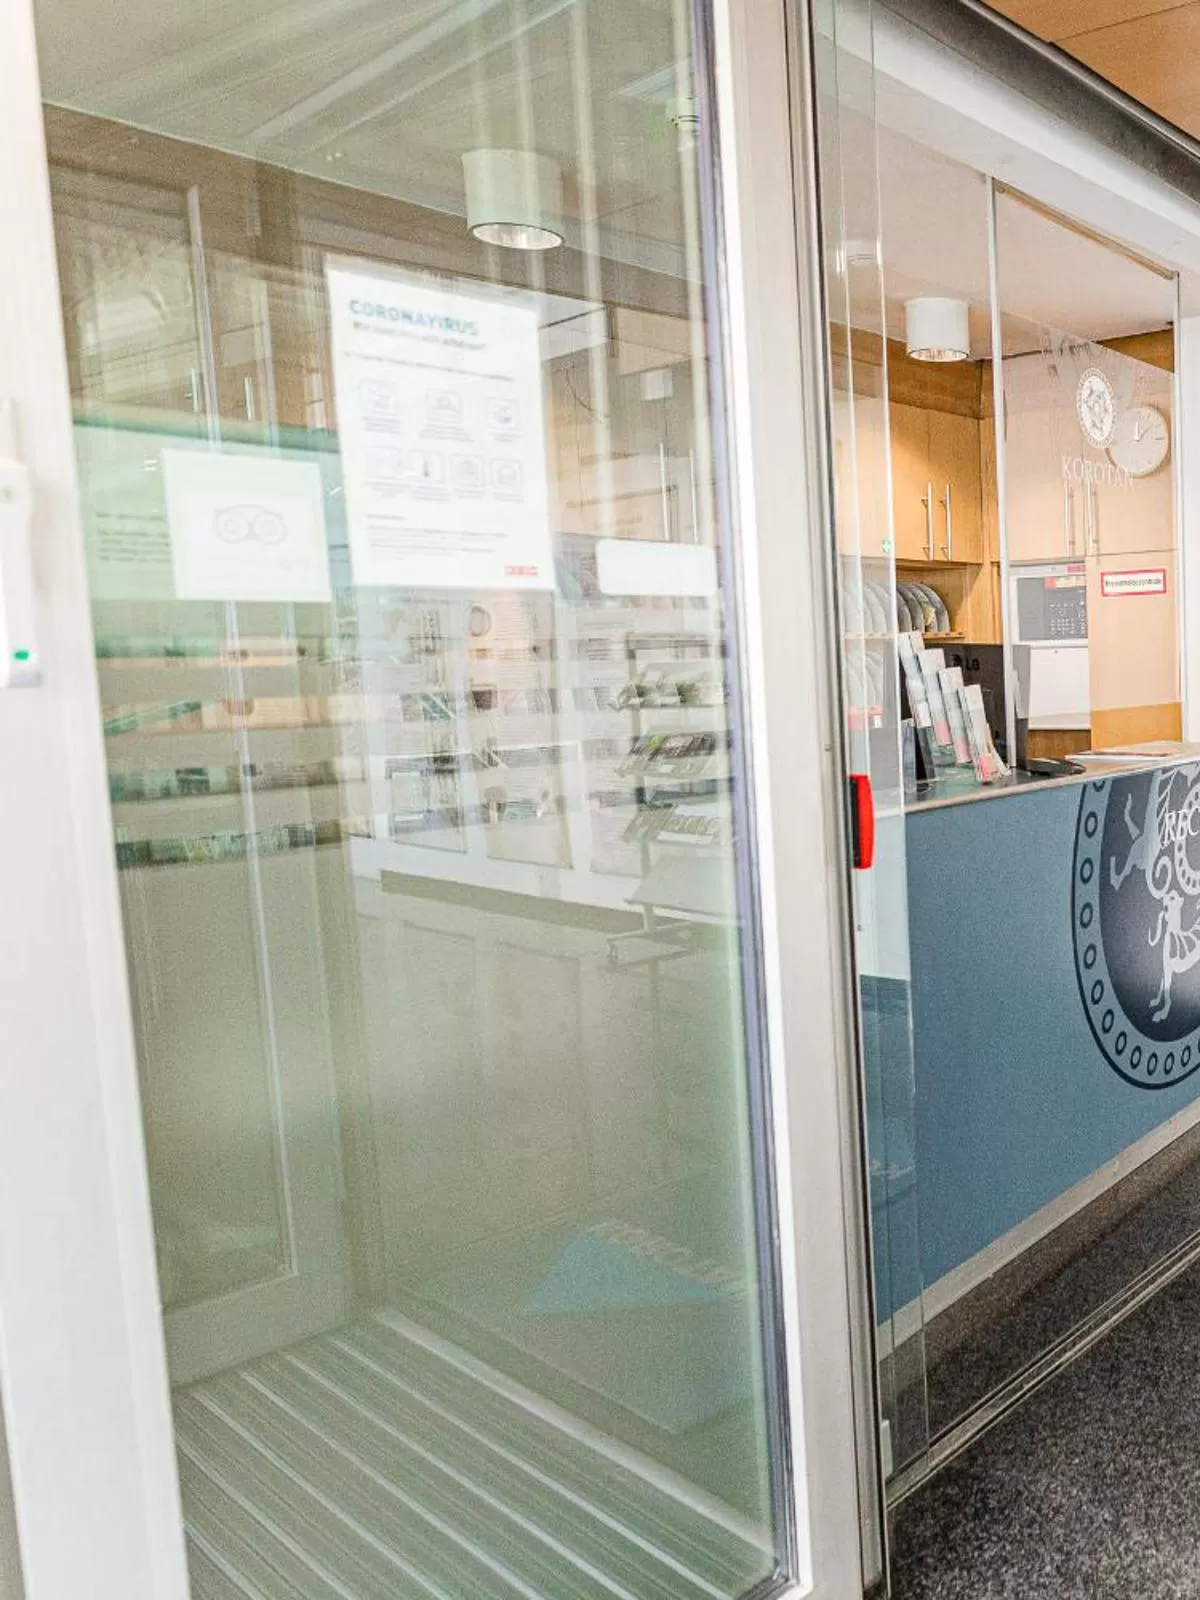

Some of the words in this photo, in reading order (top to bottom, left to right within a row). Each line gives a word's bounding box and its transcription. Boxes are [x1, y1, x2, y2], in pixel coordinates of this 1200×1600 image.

[349, 299, 478, 336] CORONAVIRUS
[1061, 456, 1134, 489] KOROTAN
[965, 655, 980, 672] LG
